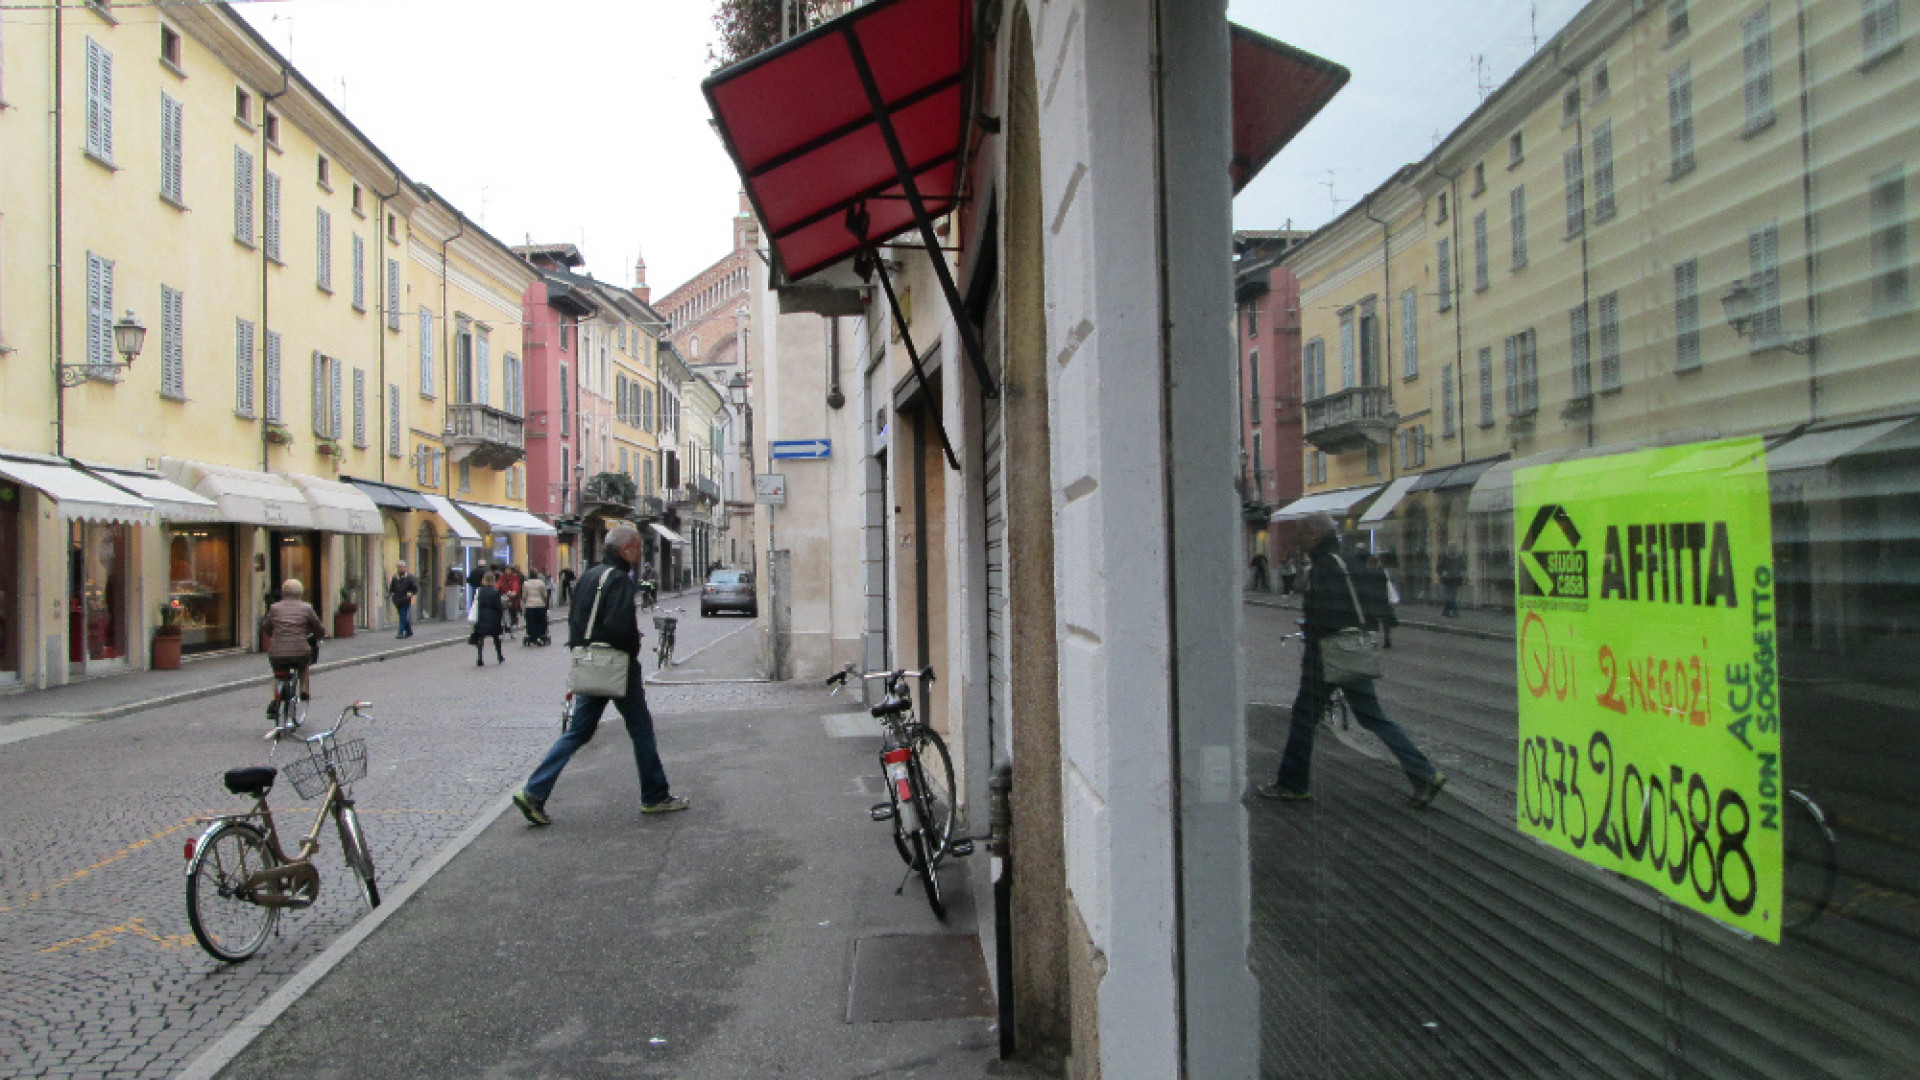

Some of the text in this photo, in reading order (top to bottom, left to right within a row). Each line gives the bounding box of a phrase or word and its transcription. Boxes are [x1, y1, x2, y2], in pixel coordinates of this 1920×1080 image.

[1557, 574, 1585, 596] casa
[1601, 521, 1738, 608] AFFITTA
[1596, 644, 1628, 715] 2
[1726, 662, 1754, 752] ACE
[1752, 565, 1778, 830] NON SOGGETTO
